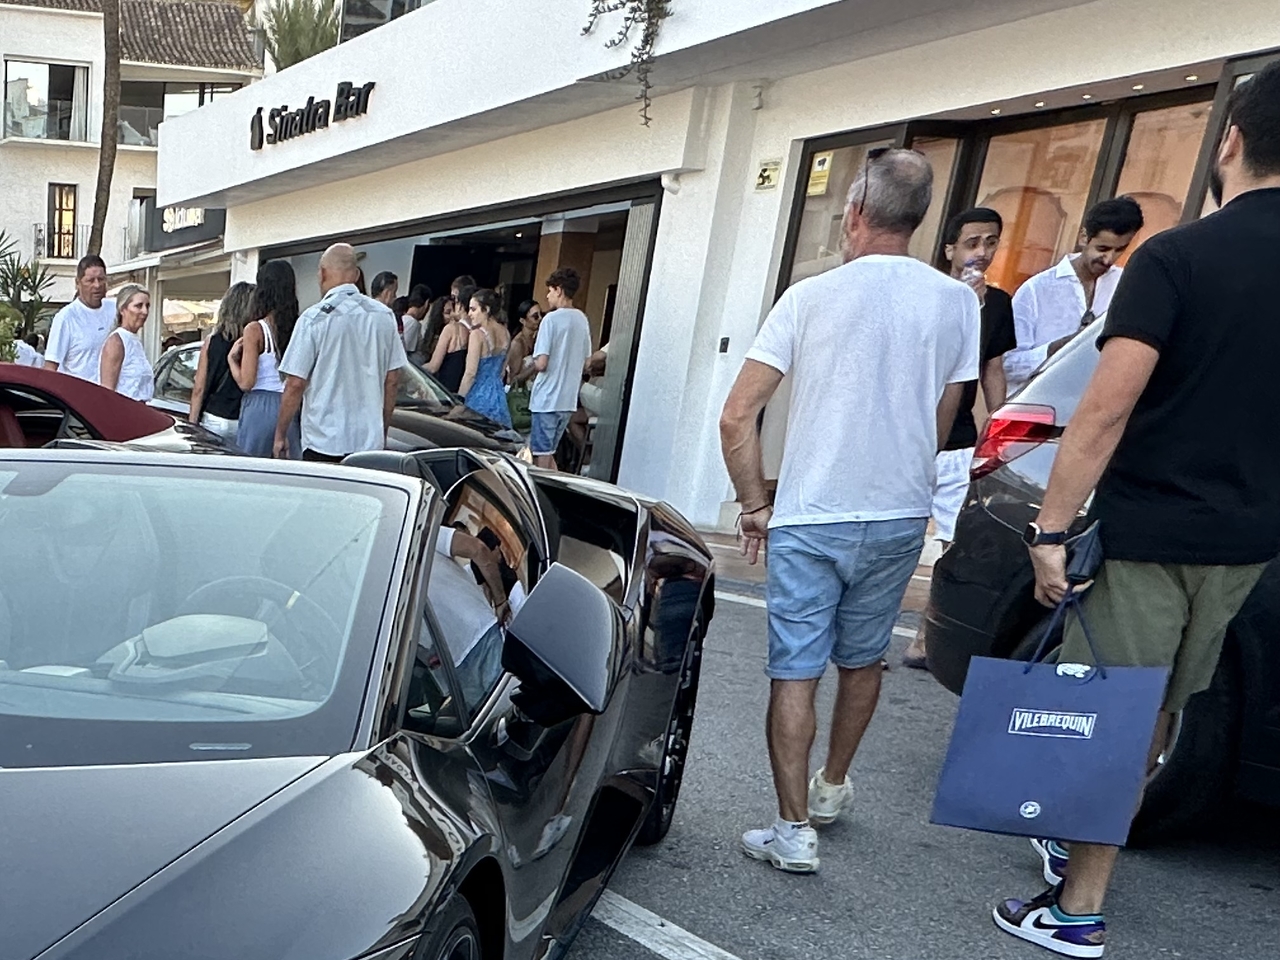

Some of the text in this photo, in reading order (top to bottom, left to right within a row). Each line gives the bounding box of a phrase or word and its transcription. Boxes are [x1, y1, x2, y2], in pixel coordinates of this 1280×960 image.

[266, 81, 376, 144] Sinatra Bar
[1014, 711, 1093, 737] VILEBREQUIN
